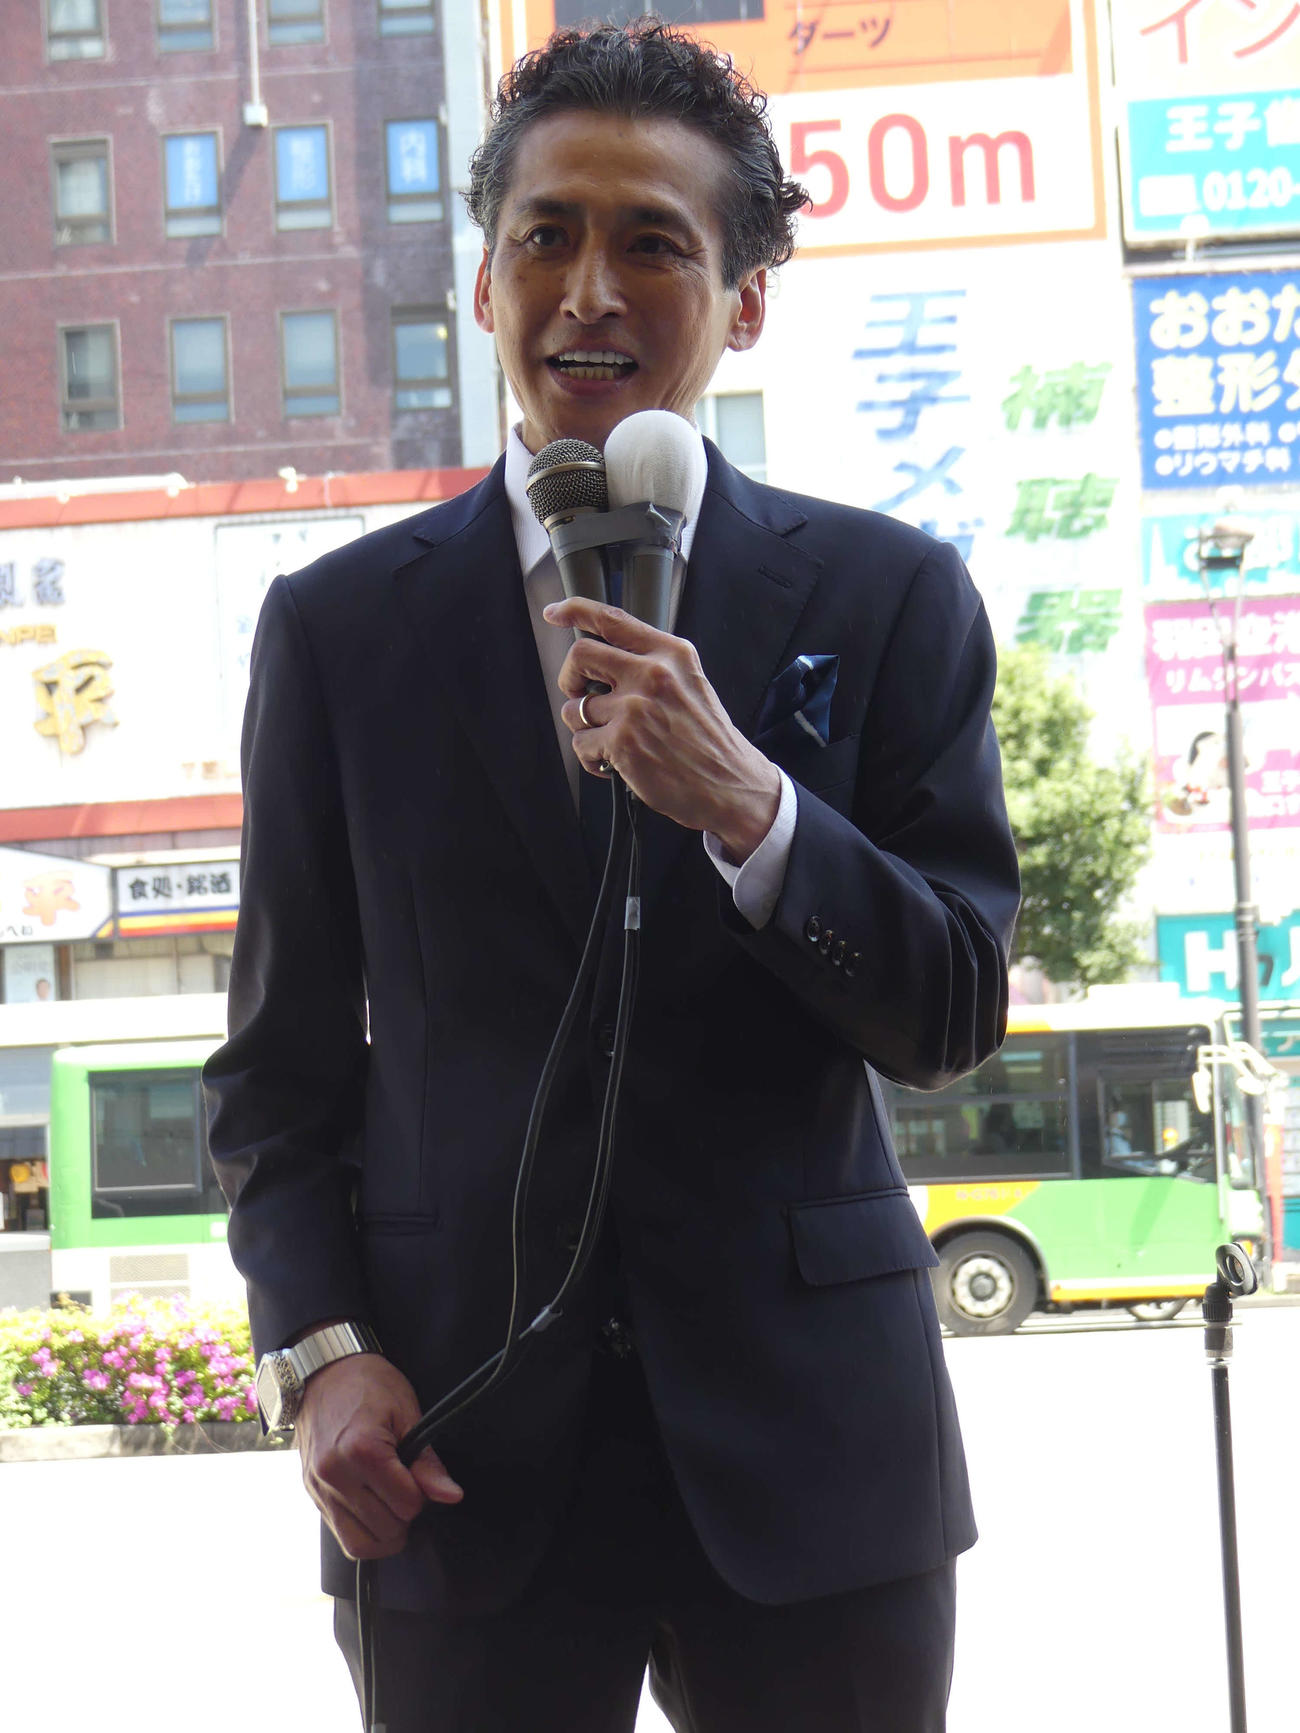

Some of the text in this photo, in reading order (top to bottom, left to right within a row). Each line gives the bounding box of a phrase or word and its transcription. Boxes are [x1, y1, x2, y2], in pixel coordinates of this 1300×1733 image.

[788, 15, 892, 55] ダーツ
[789, 113, 1036, 219] 50m
[1151, 349, 1300, 416] 整形
